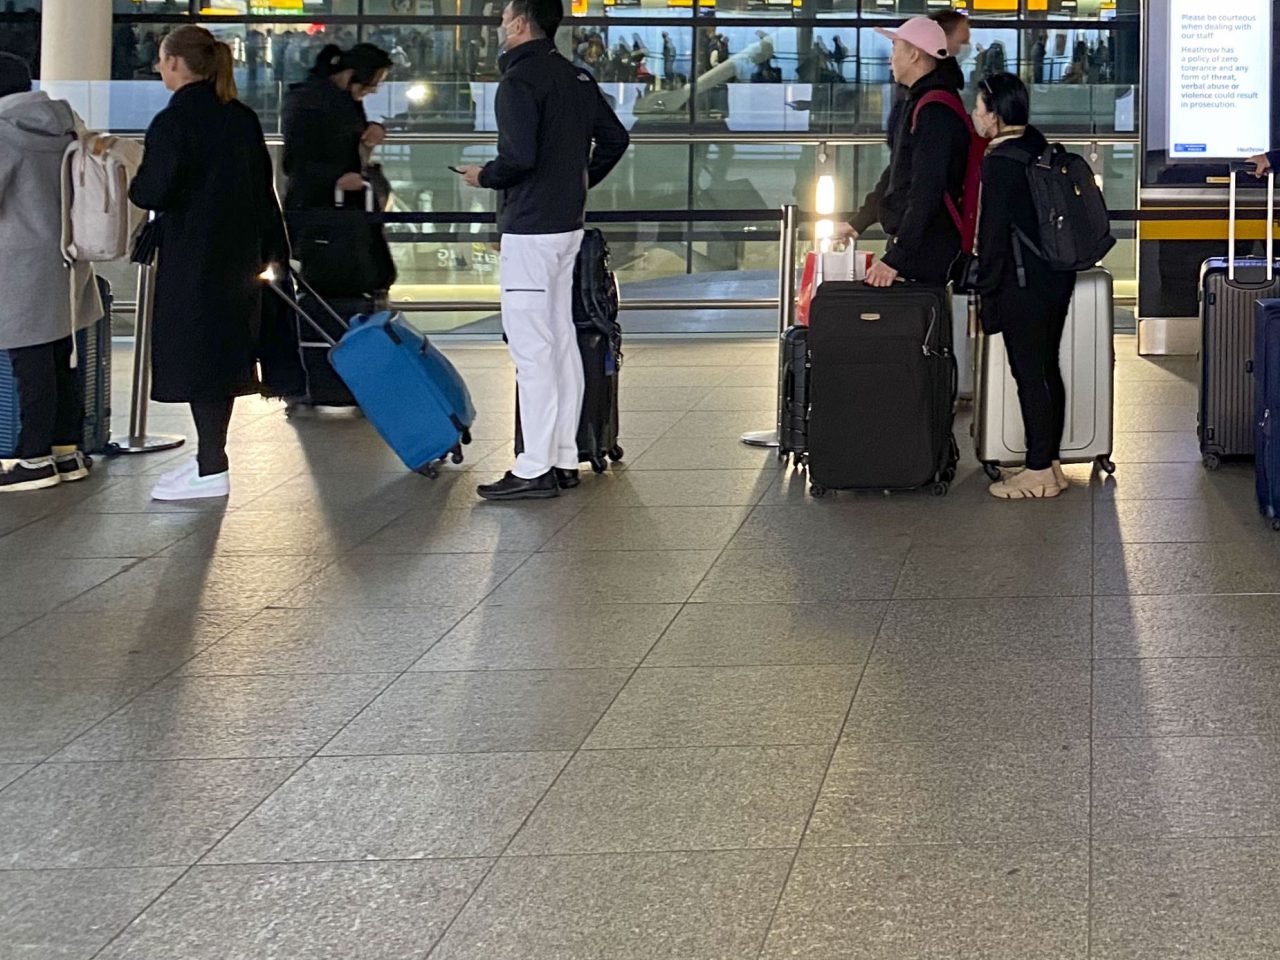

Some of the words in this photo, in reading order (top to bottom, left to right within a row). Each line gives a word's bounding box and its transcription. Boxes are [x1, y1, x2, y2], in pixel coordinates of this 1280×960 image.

[1204, 23, 1234, 32] dealing
[1235, 23, 1252, 31] with
[1196, 31, 1214, 39] staff
[1181, 46, 1220, 54] Heathrow
[1221, 46, 1234, 54] has
[1187, 55, 1210, 64] policy
[1211, 55, 1220, 63] of
[1181, 64, 1217, 72] tolerance
[1219, 64, 1233, 72] and
[1181, 73, 1200, 81] form
[1201, 73, 1209, 81] of
[1211, 73, 1237, 82] threat,
[1181, 82, 1205, 90] verbal
[1207, 82, 1229, 90] abuse
[1181, 91, 1212, 99] violence
[1214, 91, 1235, 99] could
[1237, 91, 1258, 99] result
[1181, 100, 1188, 108] in
[1189, 100, 1236, 109] prosecution.
